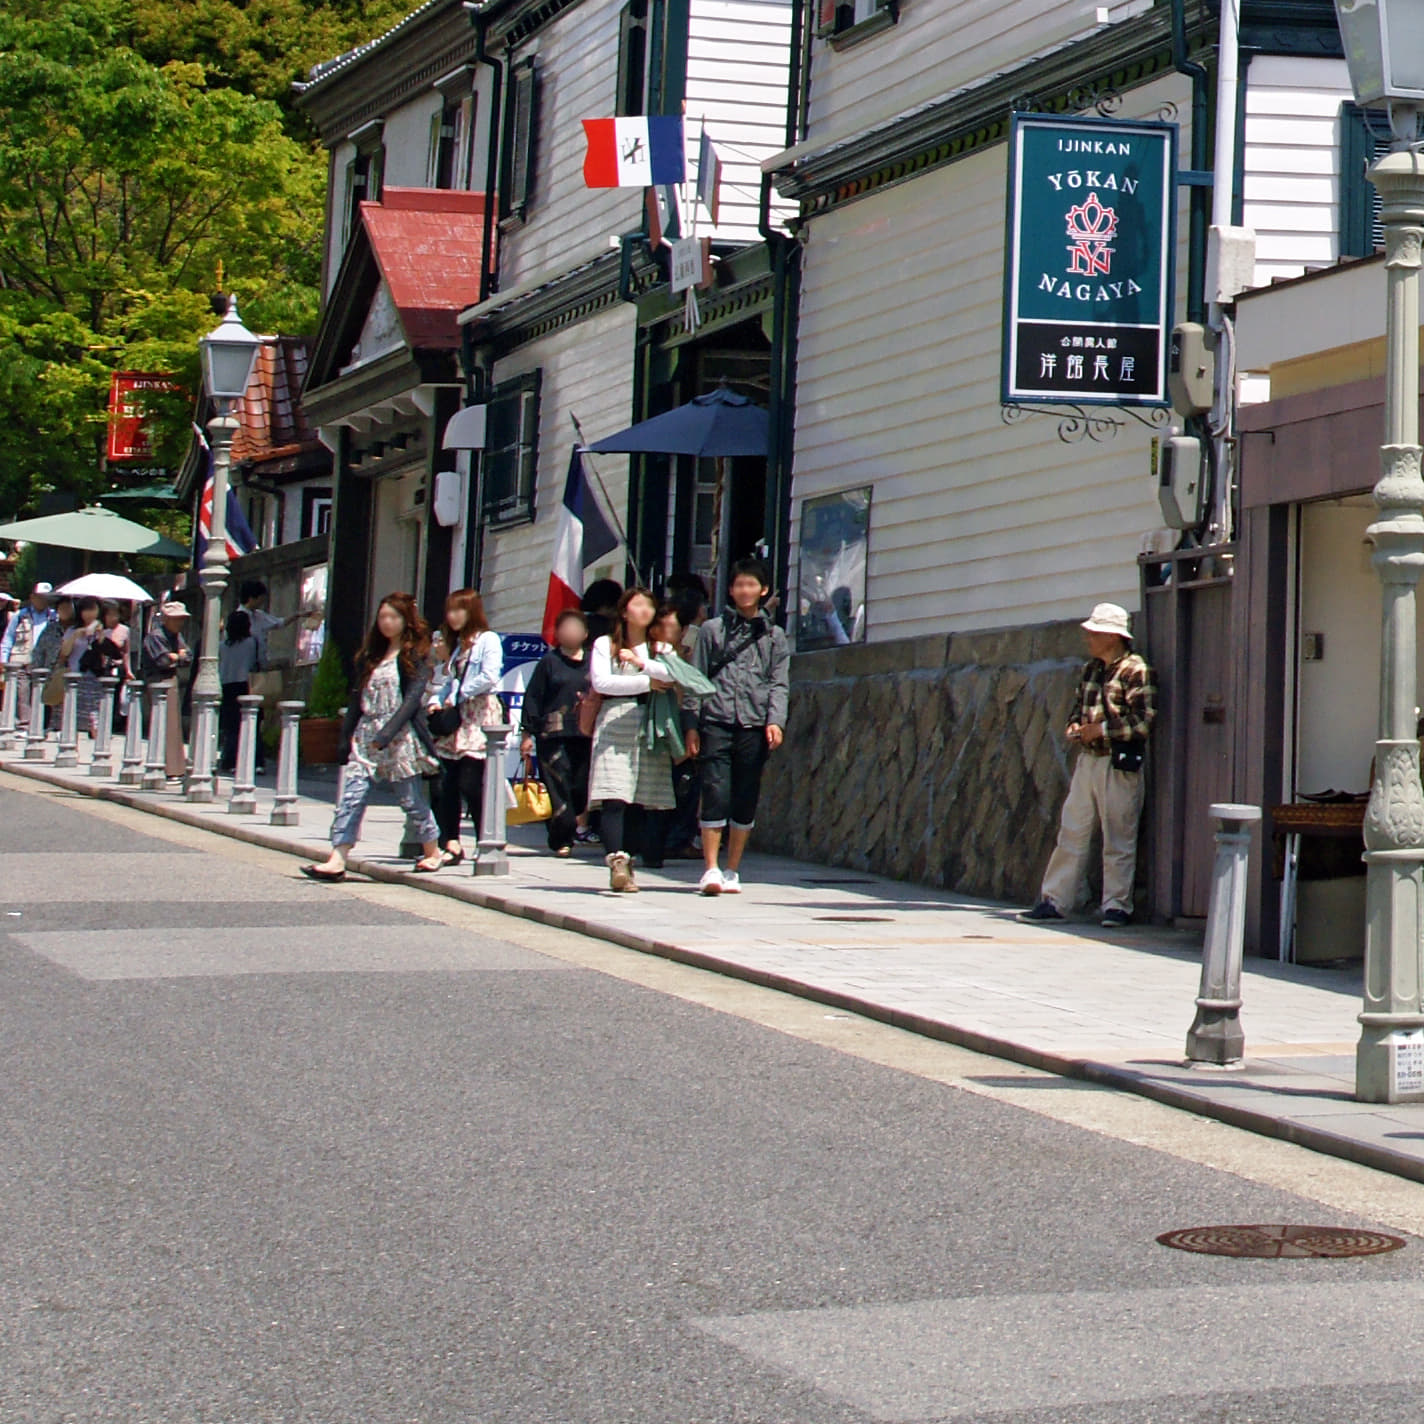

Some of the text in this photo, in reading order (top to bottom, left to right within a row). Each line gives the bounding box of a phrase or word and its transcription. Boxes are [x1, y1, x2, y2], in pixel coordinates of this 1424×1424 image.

[1057, 138, 1131, 156] IJINKAN
[1047, 170, 1140, 196] YŌKAN
[1038, 272, 1143, 302] NAGAYA
[1040, 352, 1136, 382] 洋館長屋
